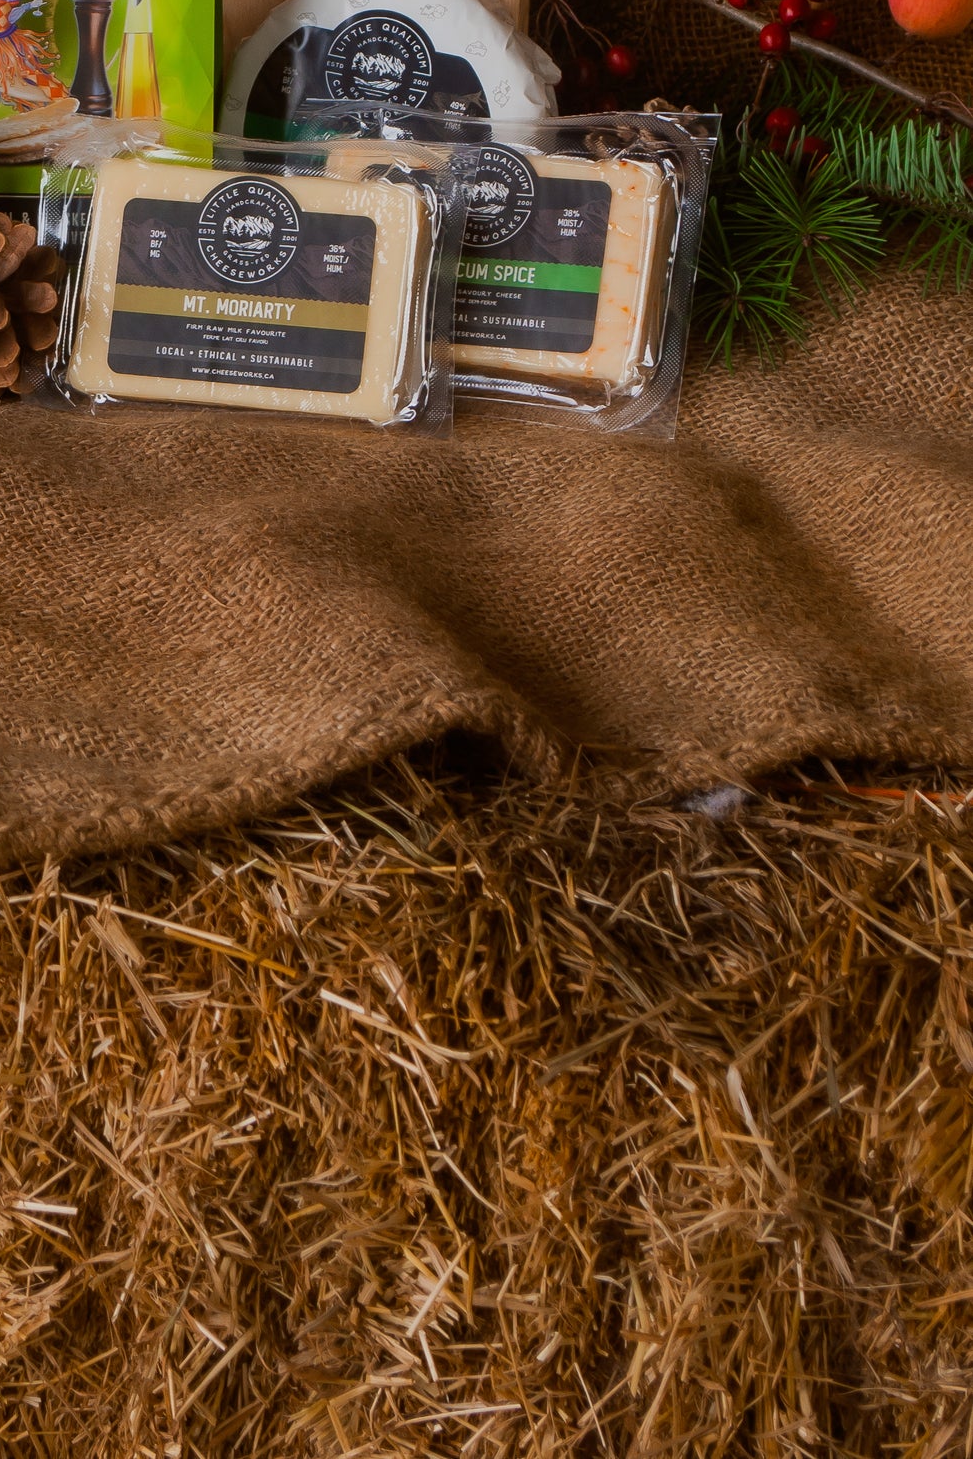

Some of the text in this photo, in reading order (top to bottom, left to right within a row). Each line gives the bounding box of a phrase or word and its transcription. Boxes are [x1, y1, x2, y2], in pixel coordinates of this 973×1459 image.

[336, 22, 427, 69] LITTLE QUALICUM
[357, 36, 410, 59] HANDCRAFTED
[326, 60, 344, 69] ESTD
[449, 100, 466, 111] 49%
[483, 152, 530, 190] QUALICUM
[206, 186, 294, 225] LITTLE QUALICUM
[225, 199, 277, 218] HANDCRAFTED
[562, 208, 580, 218] 38%
[149, 229, 167, 239] 30%
[464, 214, 522, 243] SEWORKS
[149, 249, 161, 258] MG
[328, 244, 346, 253] 36%
[206, 245, 287, 279] CHEESEWORKS
[222, 250, 270, 267] GRASS-FED
[457, 262, 536, 284] CUM SPICE
[457, 288, 522, 300] SAVOURY CHEESE
[183, 295, 296, 321] MT. MORIARTY
[186, 323, 203, 331] FIRM
[245, 328, 287, 338] FAVOURITE
[482, 315, 546, 329] SUSTAINABLE
[156, 346, 314, 368] LOCAL ETHICAL SUSTAINABLE
[191, 366, 275, 380] WWW.CHEESEWORKS.CA
